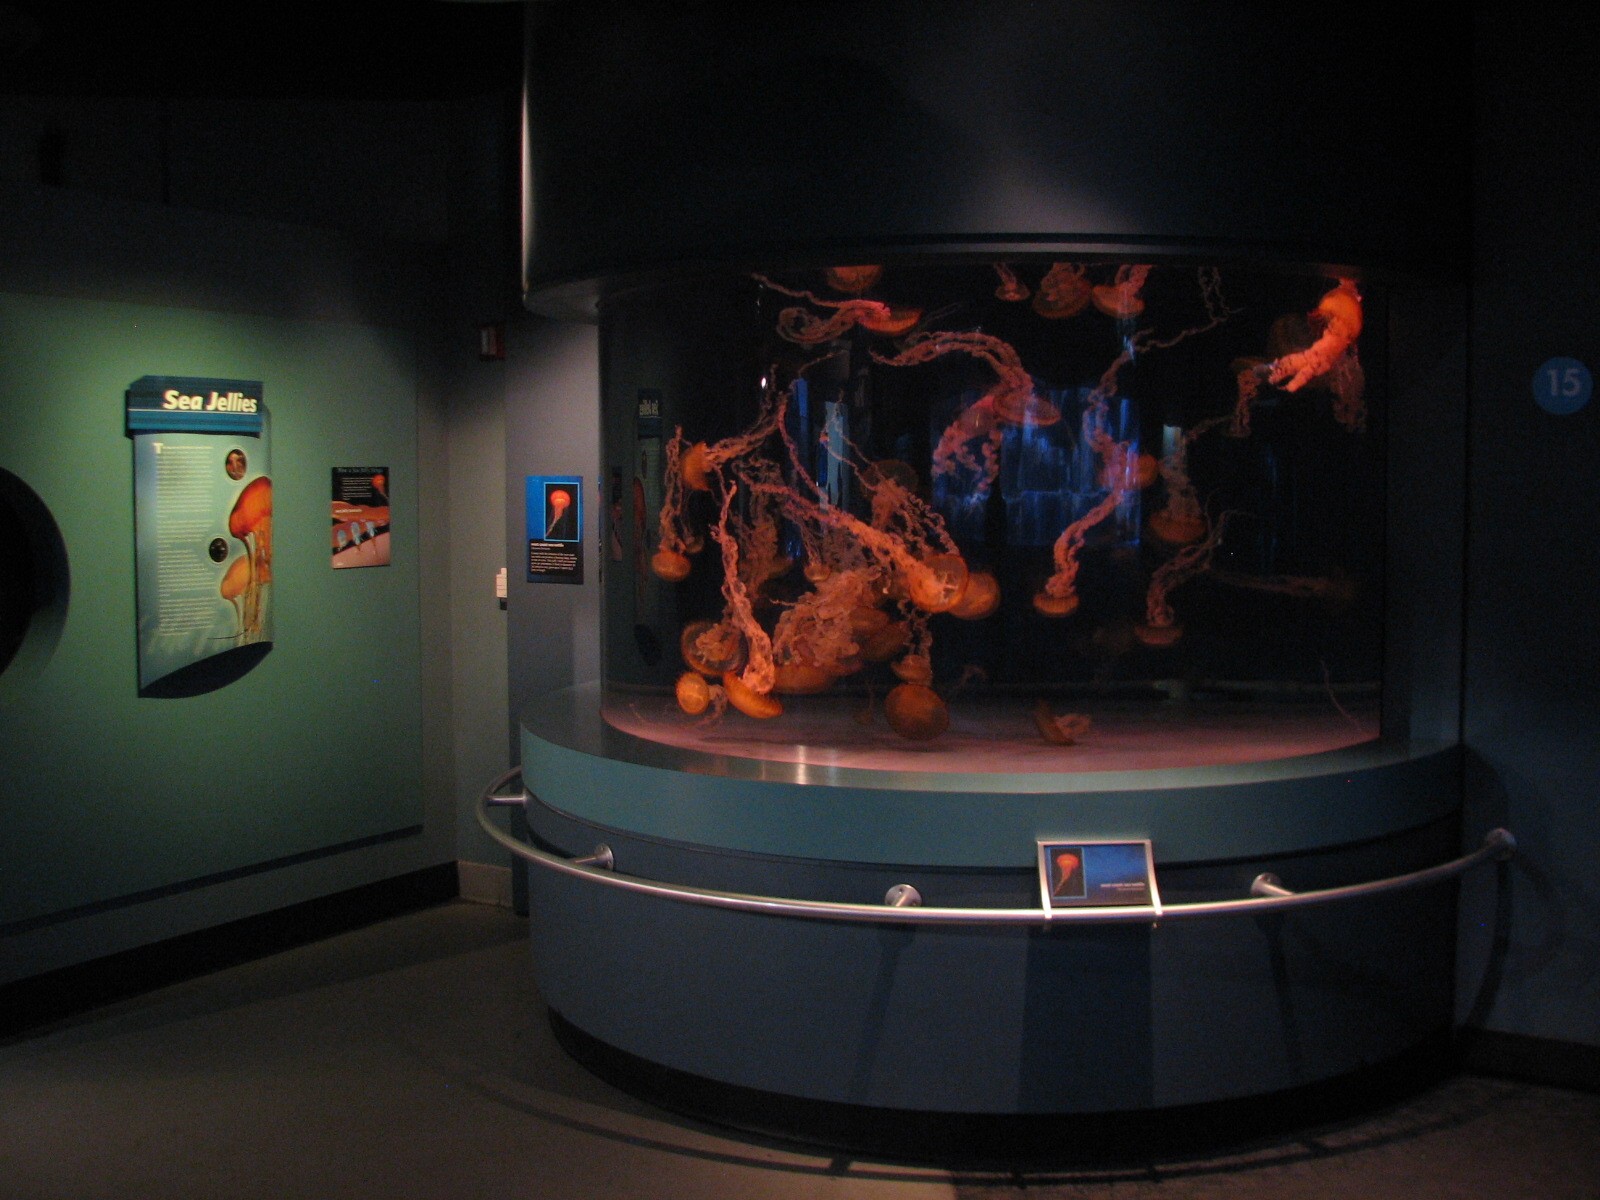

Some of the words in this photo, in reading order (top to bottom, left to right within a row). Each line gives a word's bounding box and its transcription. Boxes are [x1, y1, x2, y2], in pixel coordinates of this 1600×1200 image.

[1547, 368, 1580, 397] 15
[162, 389, 204, 410] Sea
[206, 391, 258, 412] Jellies
